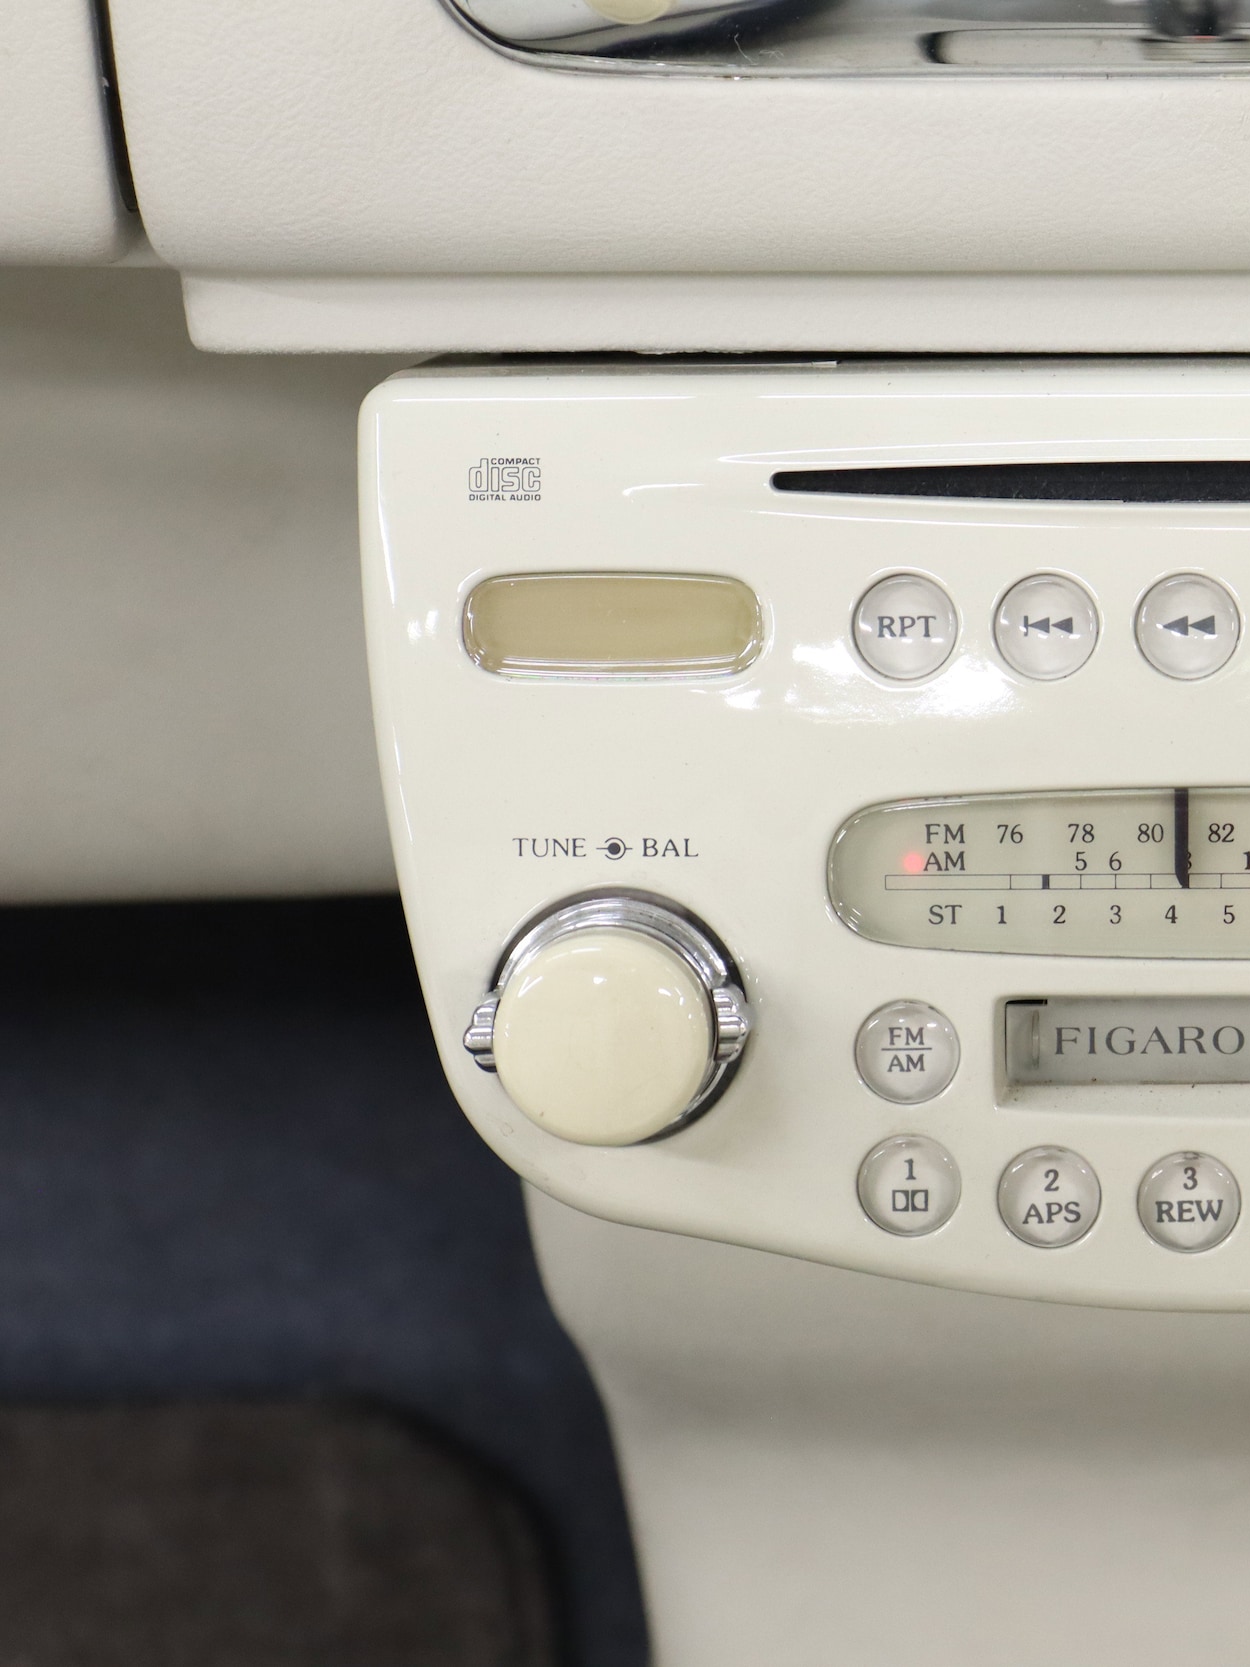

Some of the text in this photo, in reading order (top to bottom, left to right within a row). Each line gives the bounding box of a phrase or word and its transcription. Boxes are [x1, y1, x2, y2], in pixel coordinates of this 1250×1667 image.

[490, 457, 540, 466] COMPACT
[468, 493, 541, 502] DIGITAL AUDIO
[877, 615, 937, 638] RPT
[924, 823, 966, 845] FM
[997, 823, 1024, 844] 76
[1067, 823, 1095, 844] 78
[1137, 823, 1165, 844] 80
[1207, 822, 1235, 843] 82
[512, 837, 699, 858] TUNE BAL
[923, 850, 966, 872] AM
[1075, 851, 1088, 871] 5
[1108, 851, 1122, 872] 6
[928, 904, 963, 925] ST
[996, 905, 1007, 925] 1
[1052, 904, 1066, 925] 2
[1109, 904, 1122, 925] 3
[1164, 904, 1178, 924] 4
[1223, 904, 1236, 925] 5
[887, 1026, 925, 1046] FM
[1054, 1025, 1245, 1056] FIGARO
[887, 1053, 925, 1073] AM
[904, 1158, 917, 1181] 1
[1044, 1168, 1060, 1192] 2
[1181, 1166, 1198, 1191] 3
[1021, 1200, 1082, 1225] APS
[1154, 1199, 1224, 1224] REW
